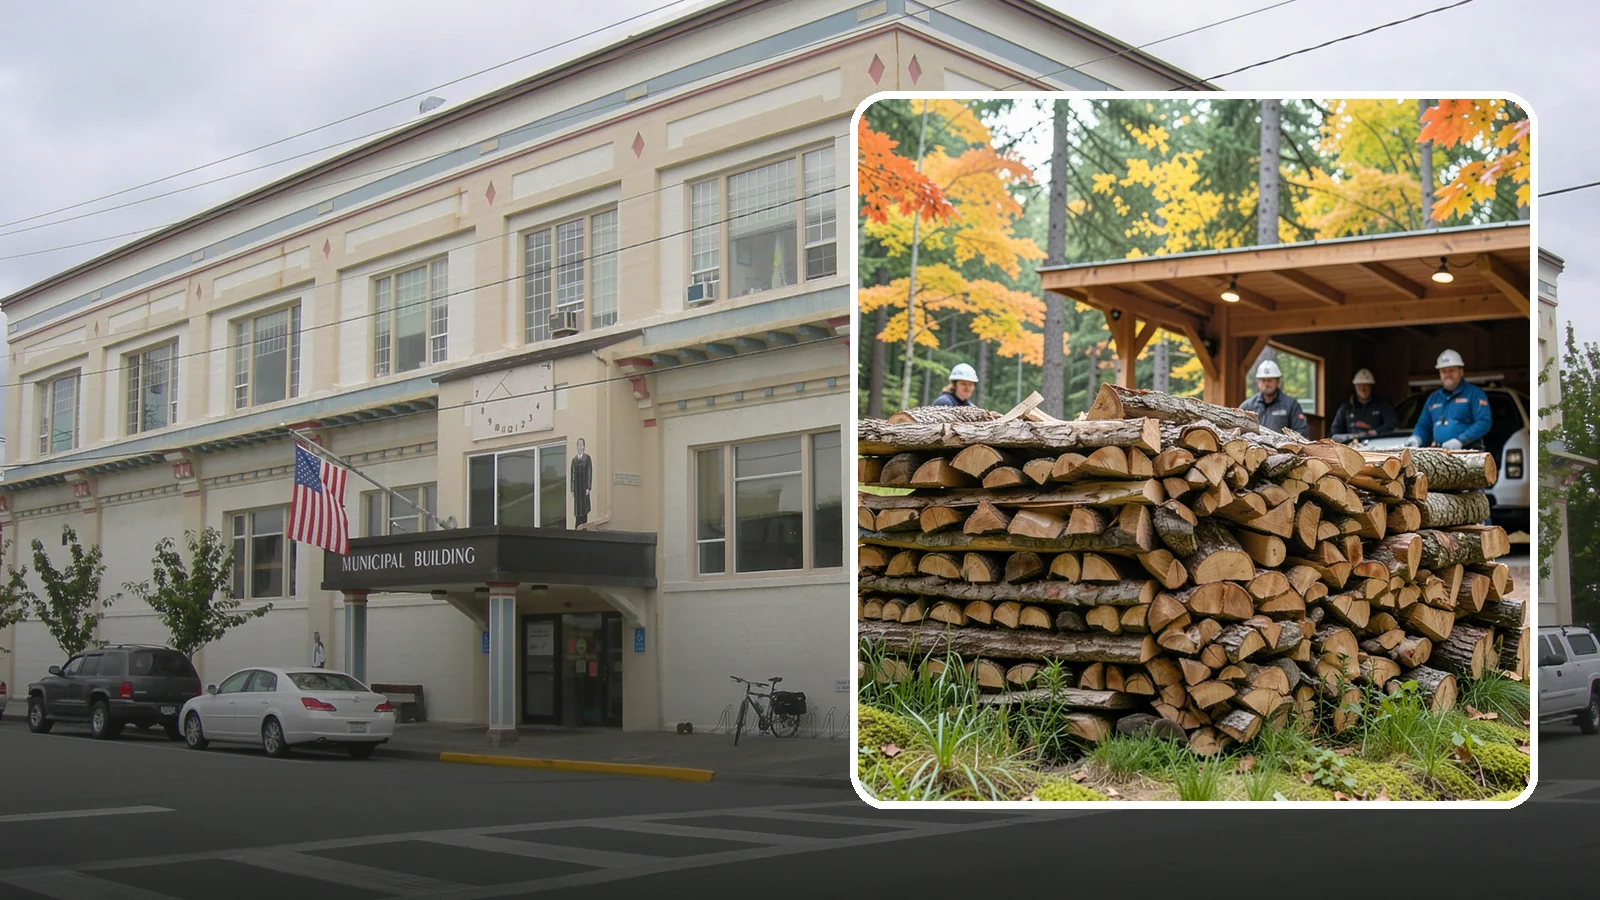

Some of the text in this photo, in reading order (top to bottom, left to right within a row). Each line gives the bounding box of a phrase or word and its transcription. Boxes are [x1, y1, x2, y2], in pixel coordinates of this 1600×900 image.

[546, 362, 552, 370] 6
[488, 418, 492, 426] 9
[494, 424, 500, 432] 10
[342, 546, 475, 572] MUNICIPAL BUILDING
